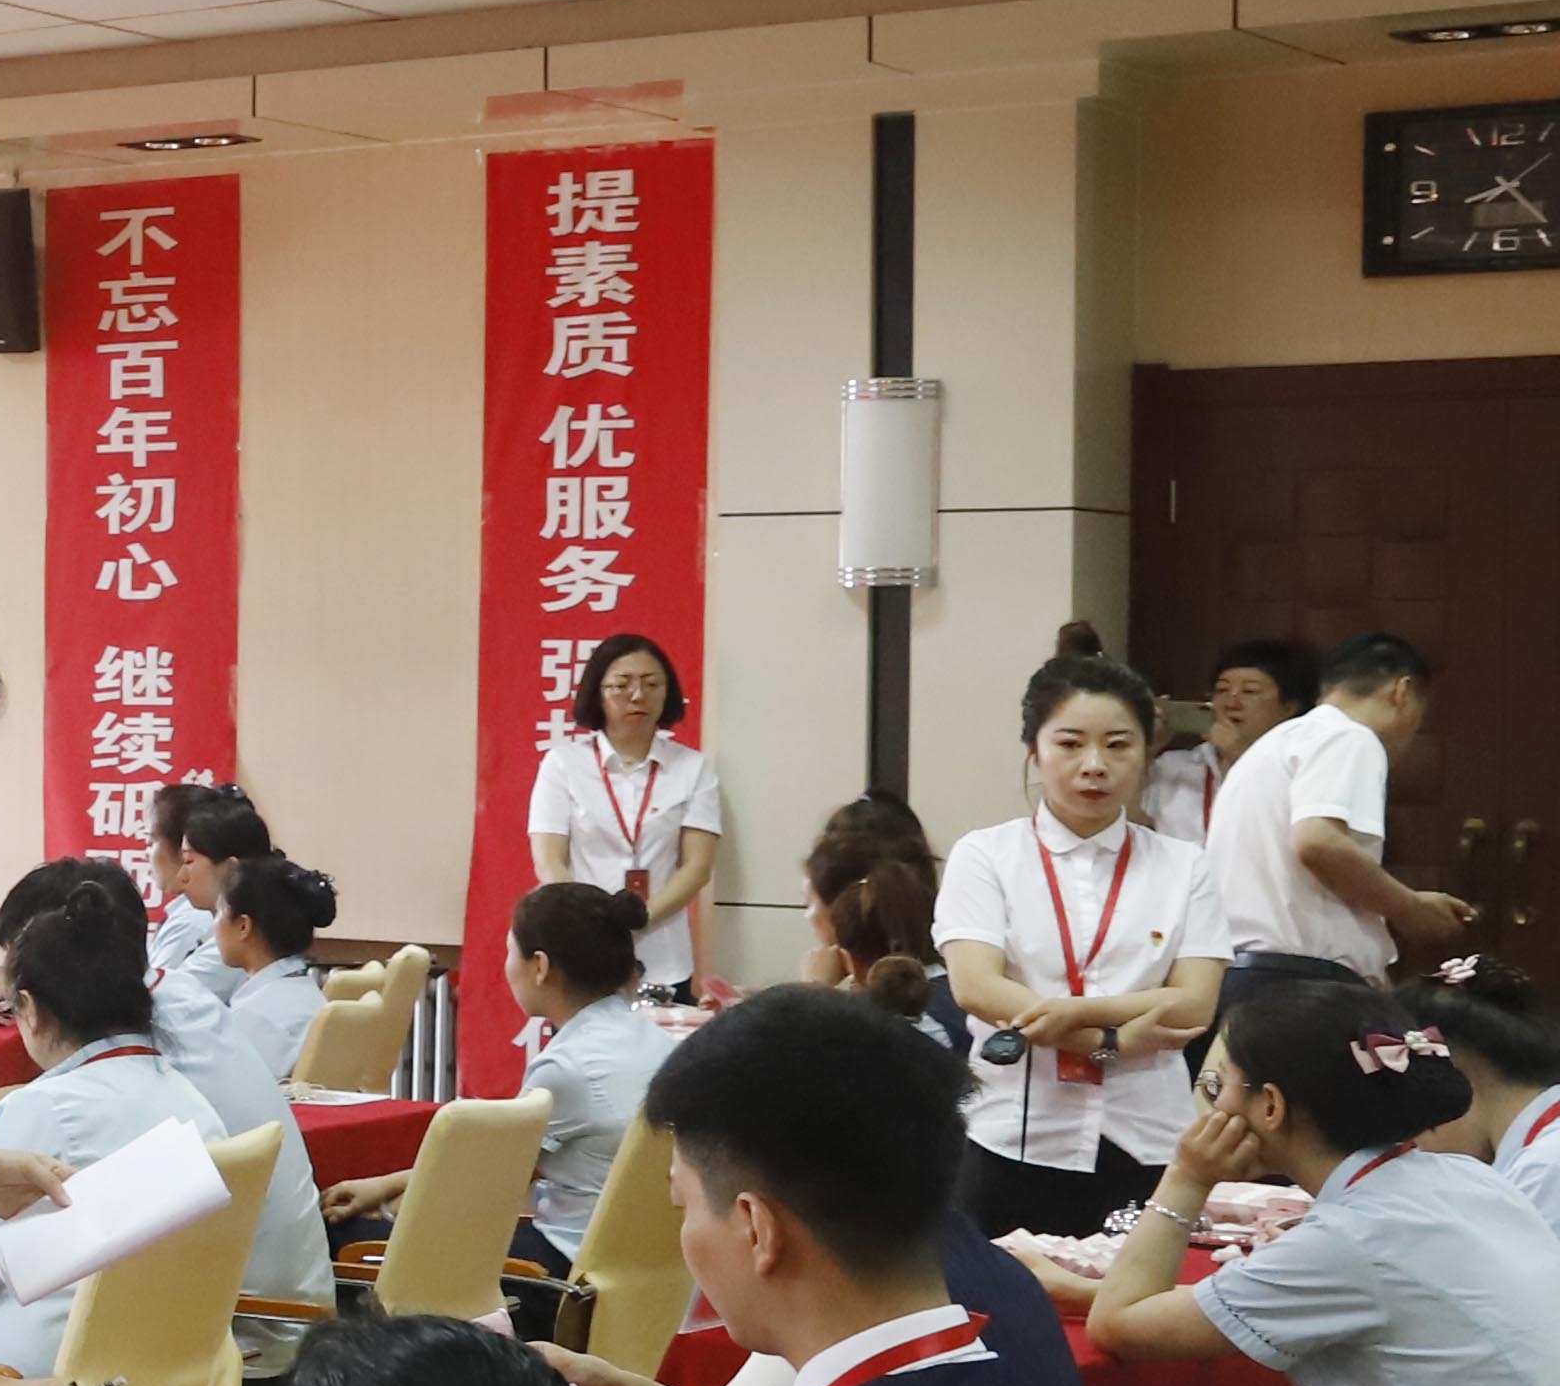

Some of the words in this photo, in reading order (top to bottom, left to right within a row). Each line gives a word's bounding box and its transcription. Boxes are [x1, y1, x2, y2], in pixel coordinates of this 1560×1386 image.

[545, 169, 641, 379] 提素质
[95, 206, 180, 601] 不忘百年初心
[539, 404, 637, 613] 优服务
